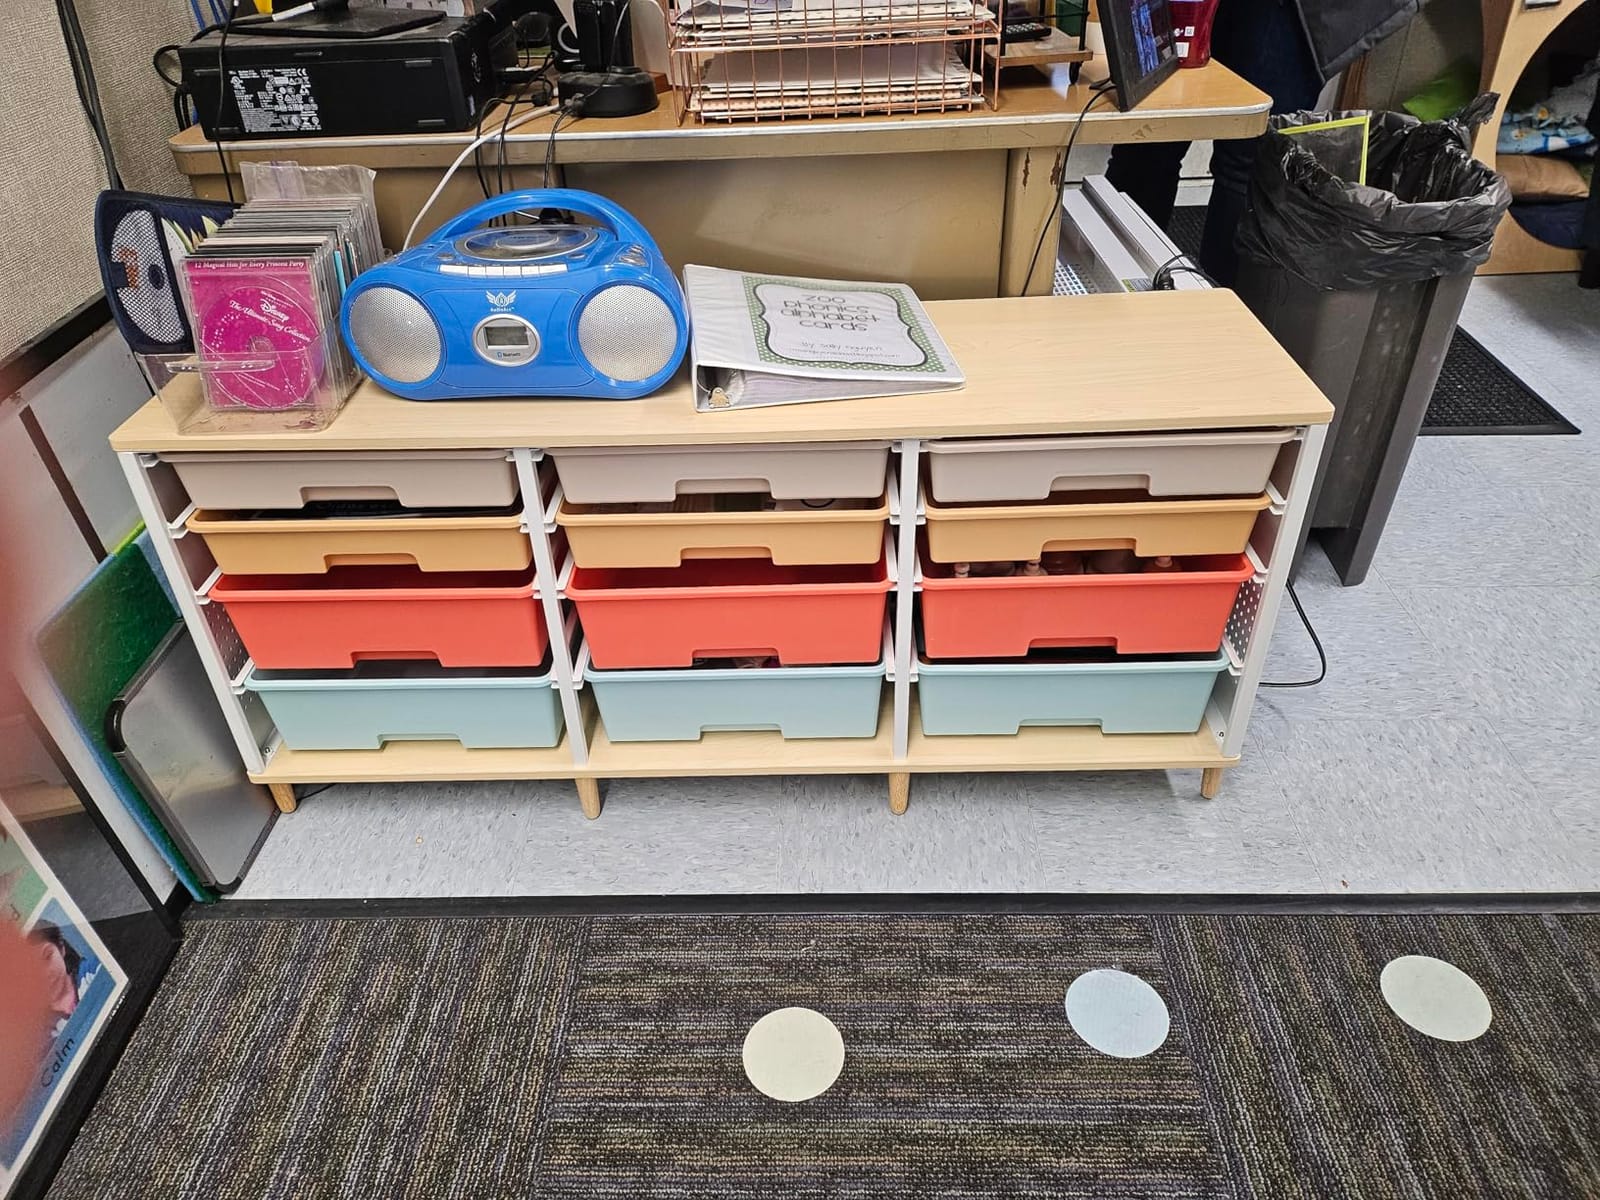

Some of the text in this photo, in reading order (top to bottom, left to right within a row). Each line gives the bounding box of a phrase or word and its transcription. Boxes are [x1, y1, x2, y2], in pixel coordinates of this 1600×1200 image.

[203, 261, 225, 270] Magical
[238, 261, 248, 270] for
[249, 261, 265, 269] Every
[266, 260, 288, 268] Princess
[289, 260, 304, 268] Party
[801, 294, 846, 304] zoo
[260, 298, 290, 323] Disney
[783, 300, 870, 314] phonics
[229, 299, 243, 311] The
[242, 307, 269, 323] Ultimate
[268, 319, 285, 332] Song
[284, 326, 312, 342] Collection
[780, 308, 881, 323] alphabet
[799, 320, 868, 332] cards
[41, 1038, 75, 1088] Calm
